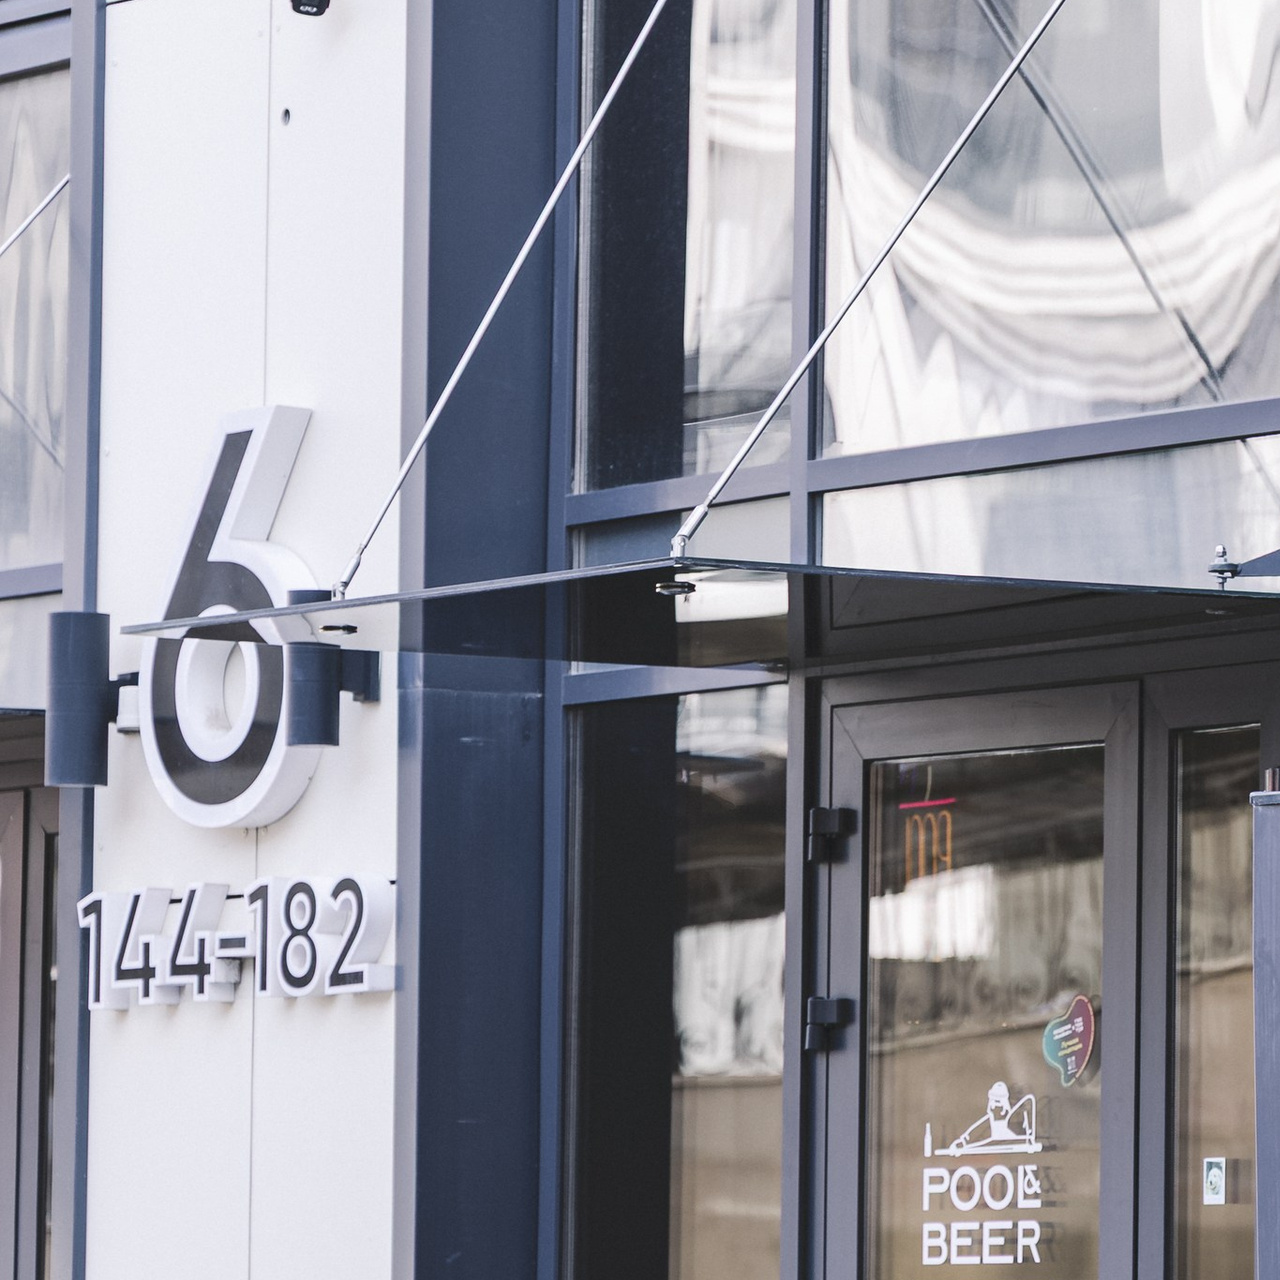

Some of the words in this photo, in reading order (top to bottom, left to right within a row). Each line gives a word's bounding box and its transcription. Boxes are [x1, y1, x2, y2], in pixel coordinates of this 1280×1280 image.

[140, 412, 302, 826] 6
[78, 878, 371, 1010] 144-182
[922, 1220, 1042, 1266] BEER
